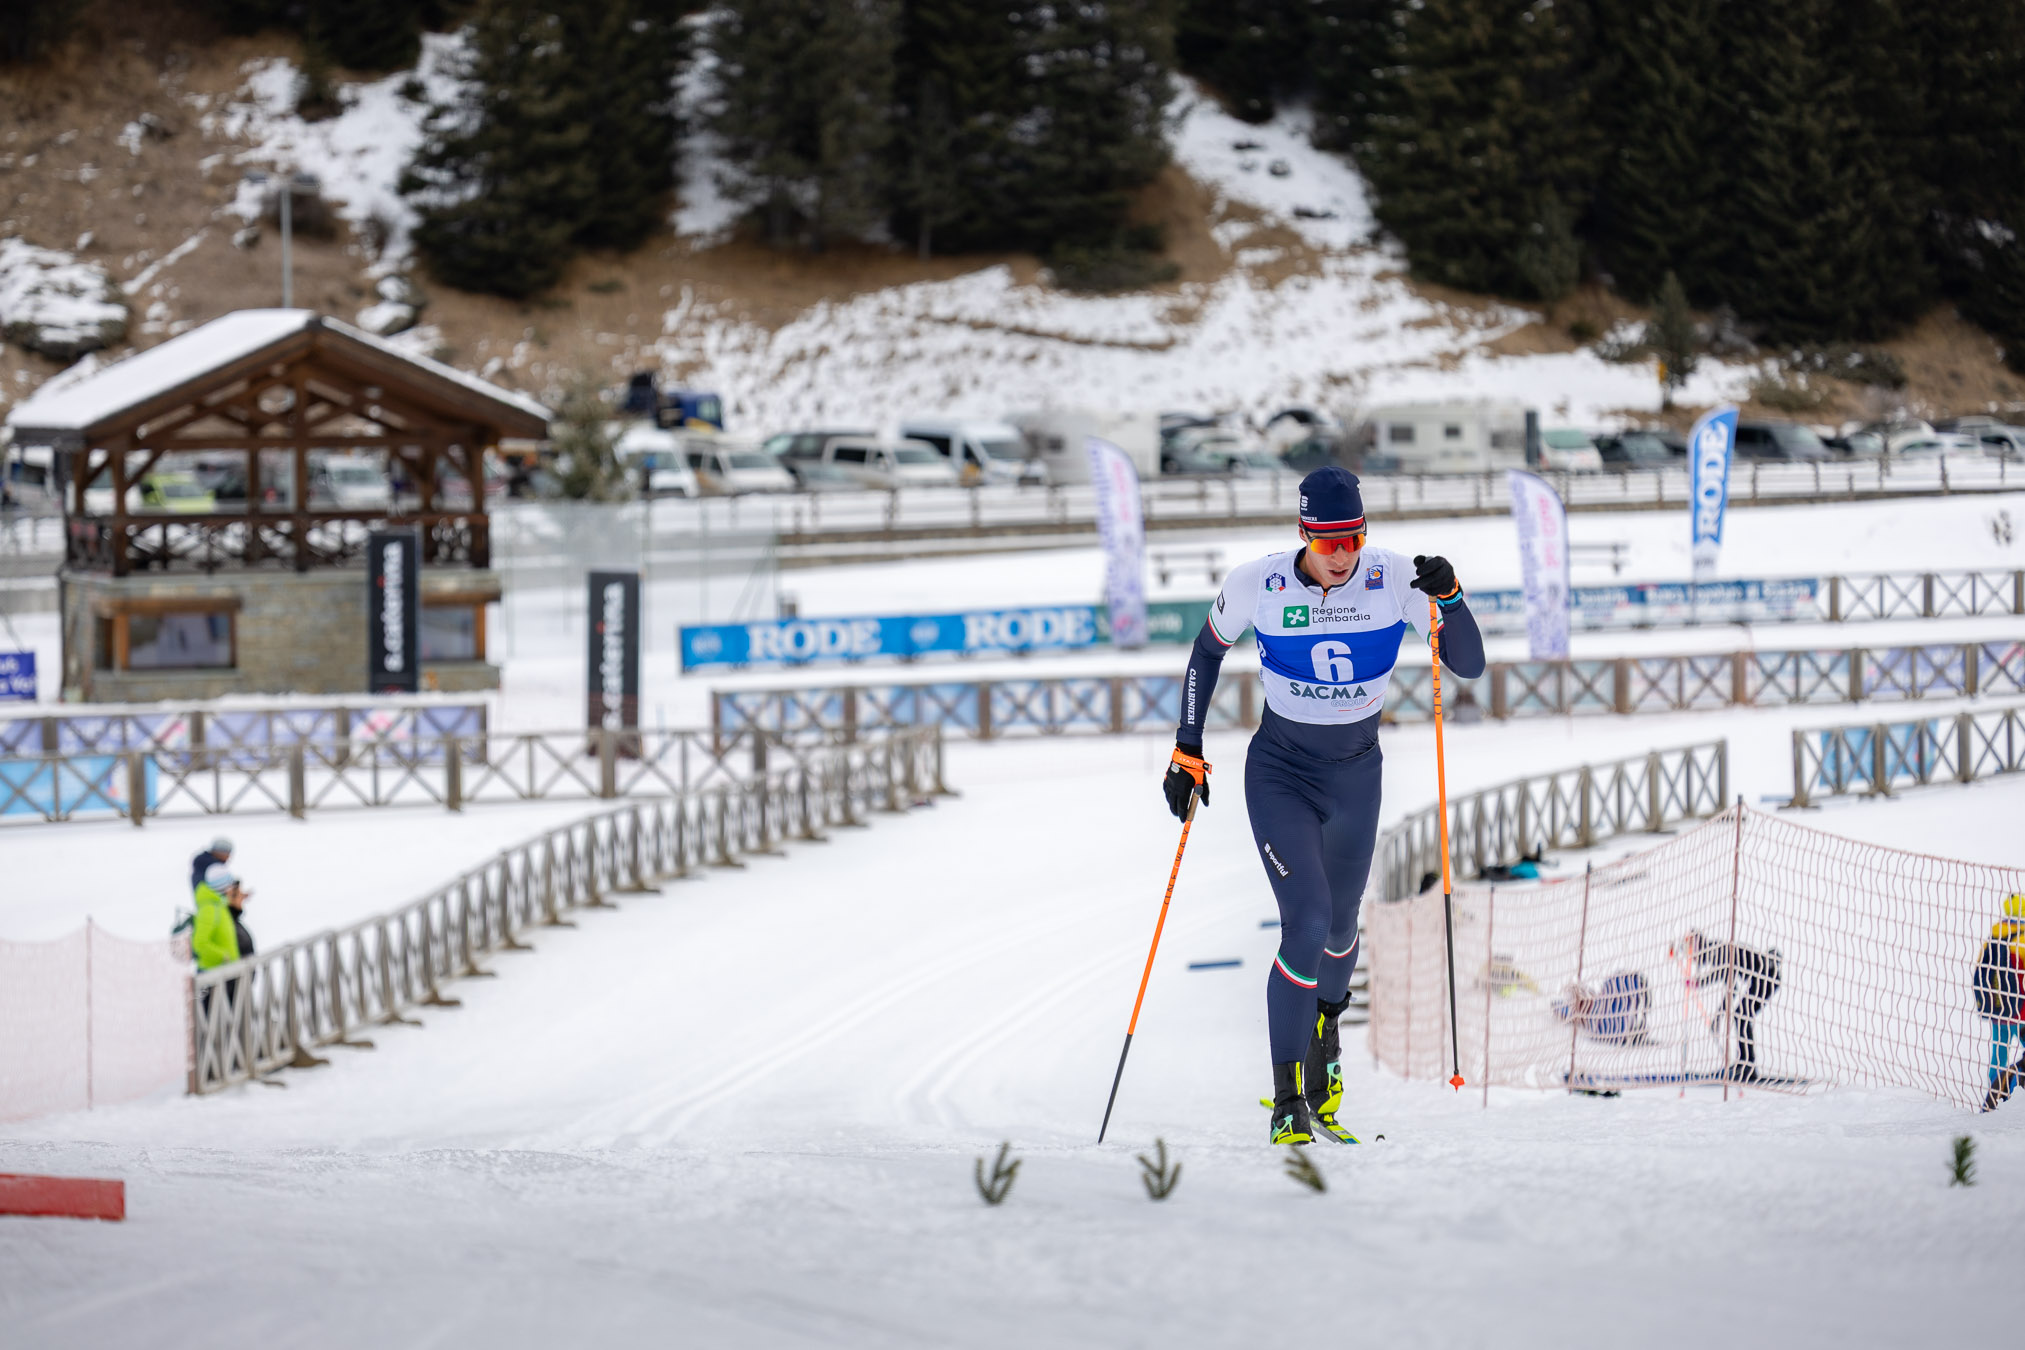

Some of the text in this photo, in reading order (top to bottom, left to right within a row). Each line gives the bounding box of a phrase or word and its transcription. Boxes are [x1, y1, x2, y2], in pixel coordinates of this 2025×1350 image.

[1698, 420, 1728, 536] RODE
[962, 606, 1094, 649] RODE
[1312, 607, 1357, 616] Regione
[1312, 613, 1371, 623] Lombardia
[746, 619, 882, 660] RODE
[1311, 640, 1354, 682] 6
[1187, 668, 1197, 725] CARABINIERI
[1289, 682, 1367, 699] SACMA
